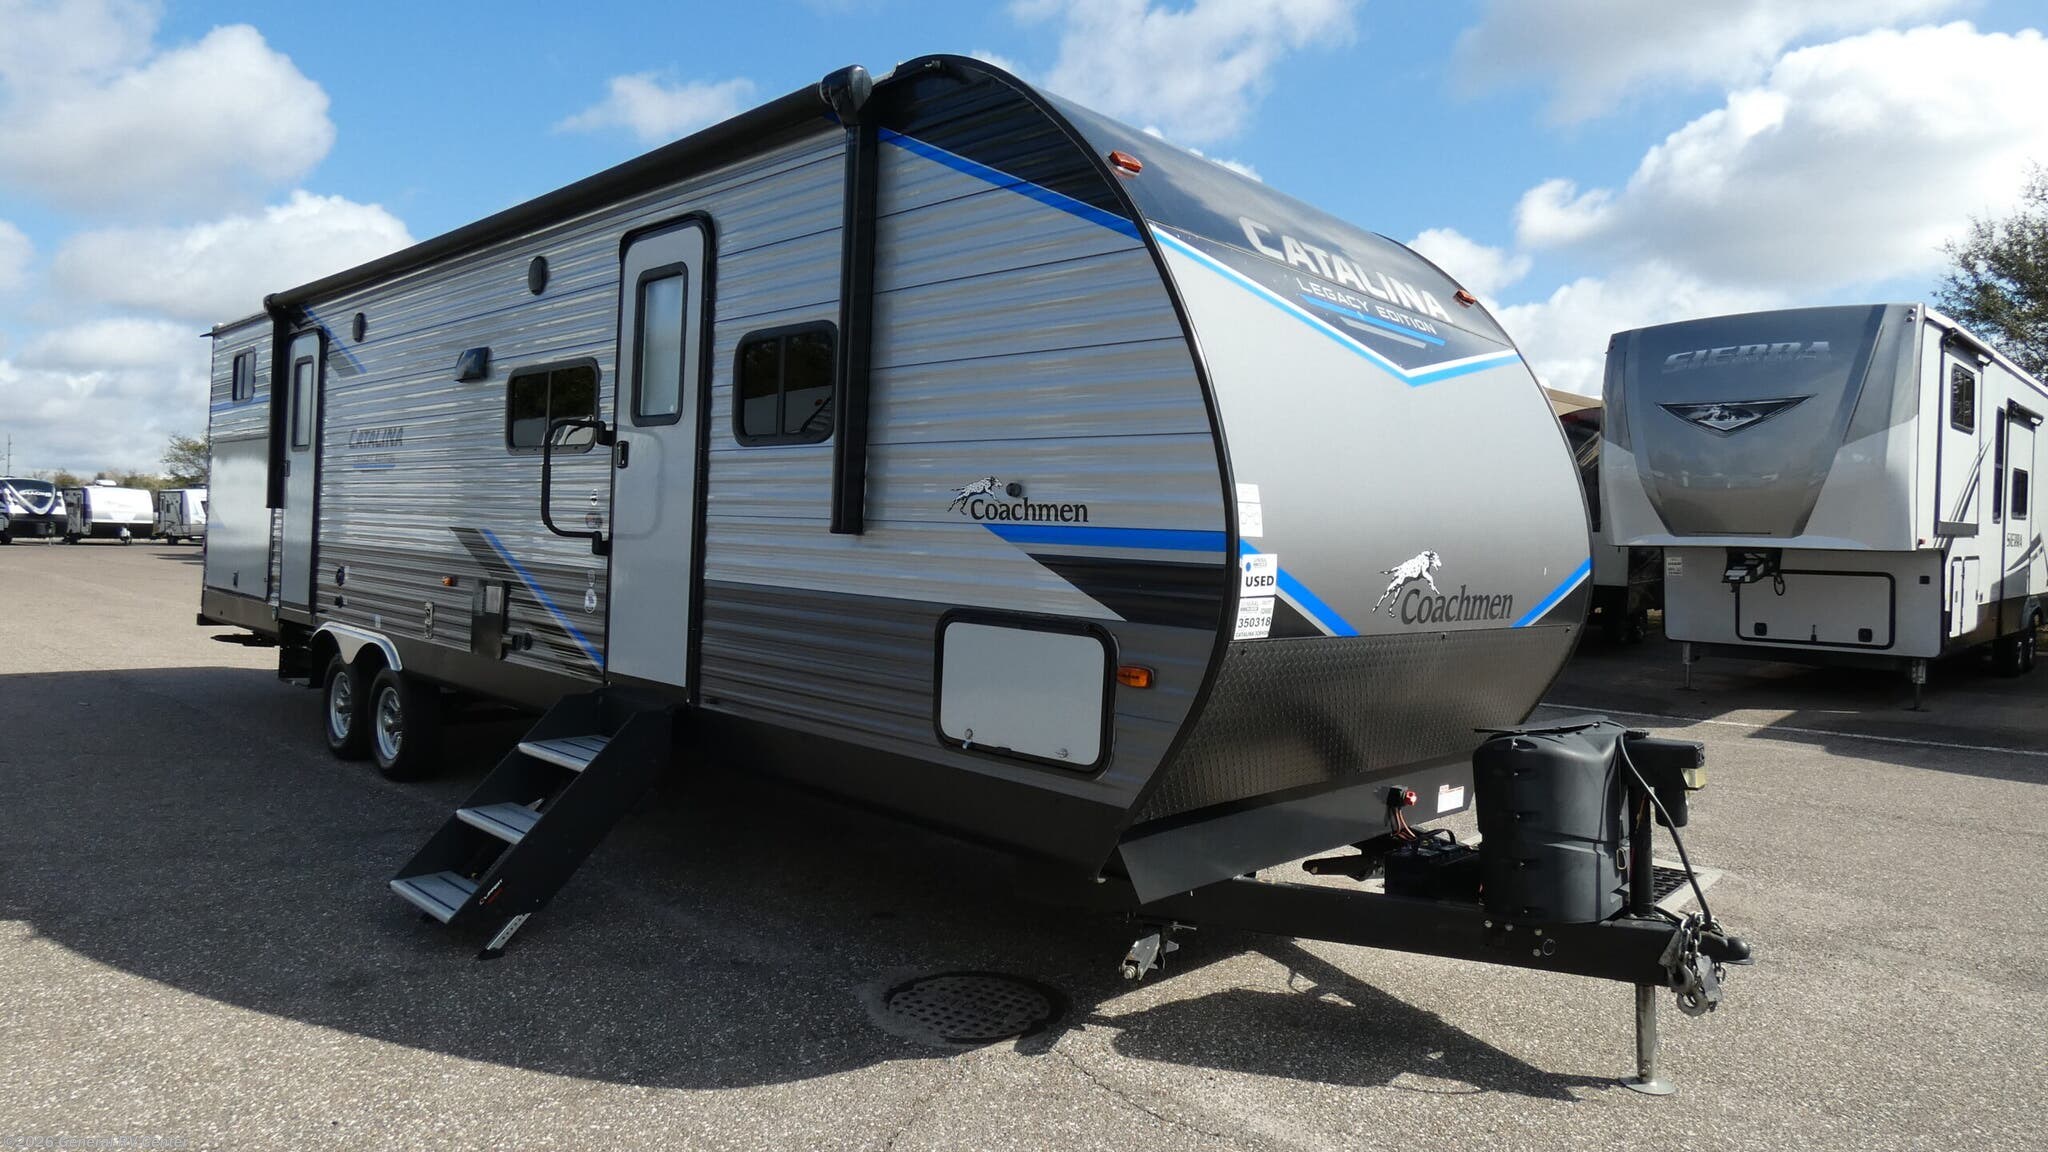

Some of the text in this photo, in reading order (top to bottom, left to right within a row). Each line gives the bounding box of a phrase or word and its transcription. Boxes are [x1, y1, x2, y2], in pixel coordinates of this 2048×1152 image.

[1238, 215, 1453, 324] CATALINA
[1296, 277, 1438, 336] LEGACY EDITION
[348, 427, 404, 449] CATALINA
[970, 497, 1089, 523] Coachmen
[1245, 575, 1275, 587] USED
[1401, 584, 1514, 625] Coachmen
[1237, 616, 1272, 628] 350318
